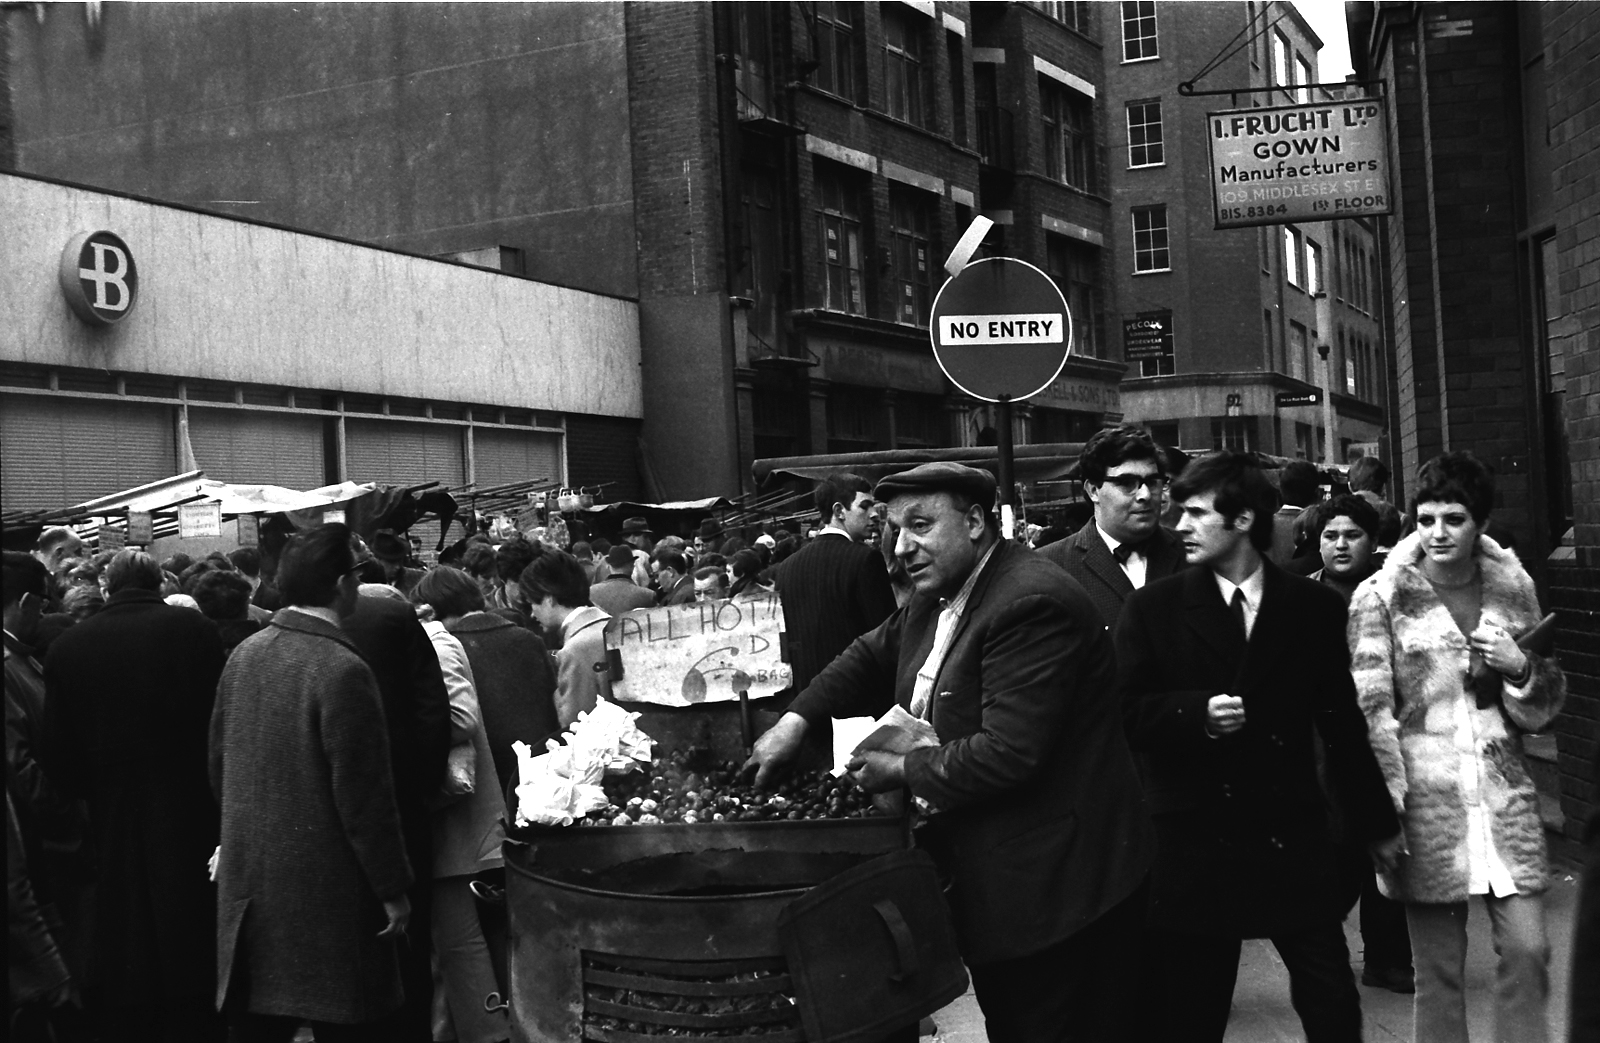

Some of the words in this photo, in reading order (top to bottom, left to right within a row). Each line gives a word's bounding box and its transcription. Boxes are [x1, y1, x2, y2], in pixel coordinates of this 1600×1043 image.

[1253, 135, 1341, 160] GOWN
[1220, 158, 1378, 184] Manufacturers
[1334, 195, 1385, 210] FLOOR
[950, 321, 980, 339] NO
[988, 320, 1053, 338] ENTRY
[1226, 393, 1242, 407] 92
[621, 609, 691, 646] ALL
[749, 634, 770, 655] D
[756, 667, 790, 683] BAG
